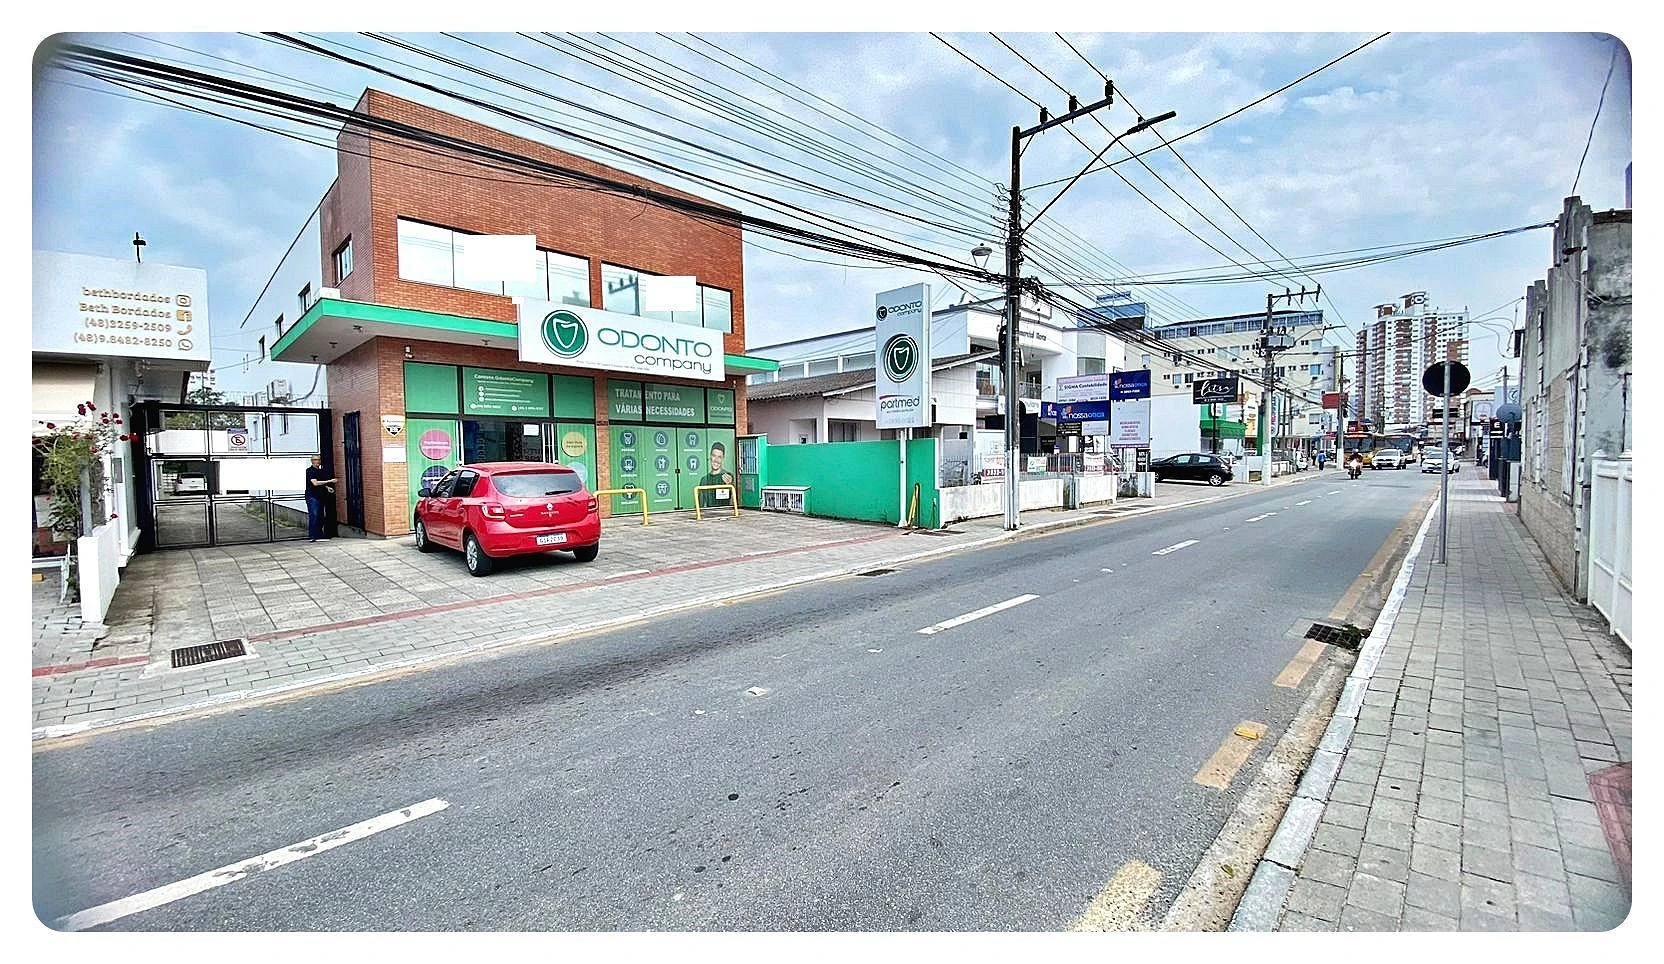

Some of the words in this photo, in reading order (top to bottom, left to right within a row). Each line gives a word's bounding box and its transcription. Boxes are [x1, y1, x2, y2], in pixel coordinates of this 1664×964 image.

[81, 286, 171, 303] bethbordados
[80, 302, 109, 313] Beth
[112, 304, 172, 318] Bordados
[888, 301, 922, 313] ODONTO
[897, 308, 922, 319] company
[85, 317, 172, 332] (48)3259-2509
[74, 332, 173, 347] (48)9.8482-8250
[597, 327, 713, 358] ODONTO
[634, 354, 712, 375] company
[663, 391, 681, 402] PARA
[645, 405, 695, 417] NECESSIDADES
[881, 397, 920, 412] partmed
